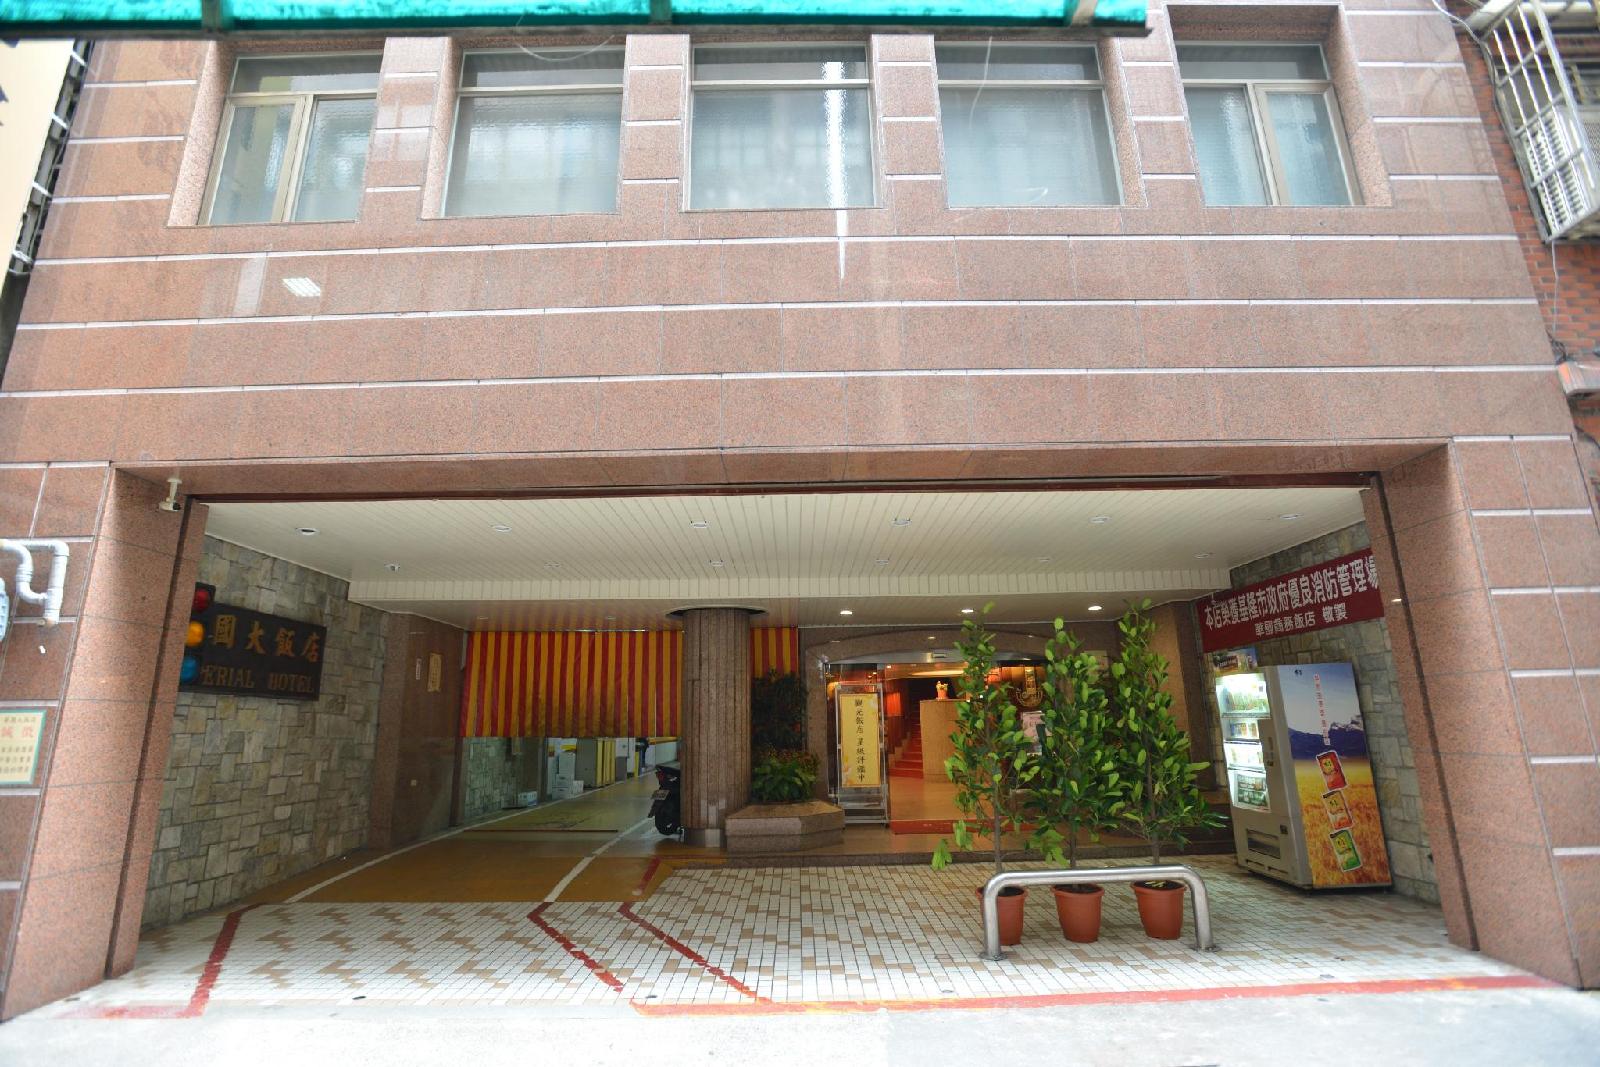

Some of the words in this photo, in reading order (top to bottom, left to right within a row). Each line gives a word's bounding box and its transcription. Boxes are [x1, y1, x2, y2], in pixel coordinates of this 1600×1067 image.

[208, 615, 320, 662] 國大飯店
[268, 673, 313, 693] HOTEL
